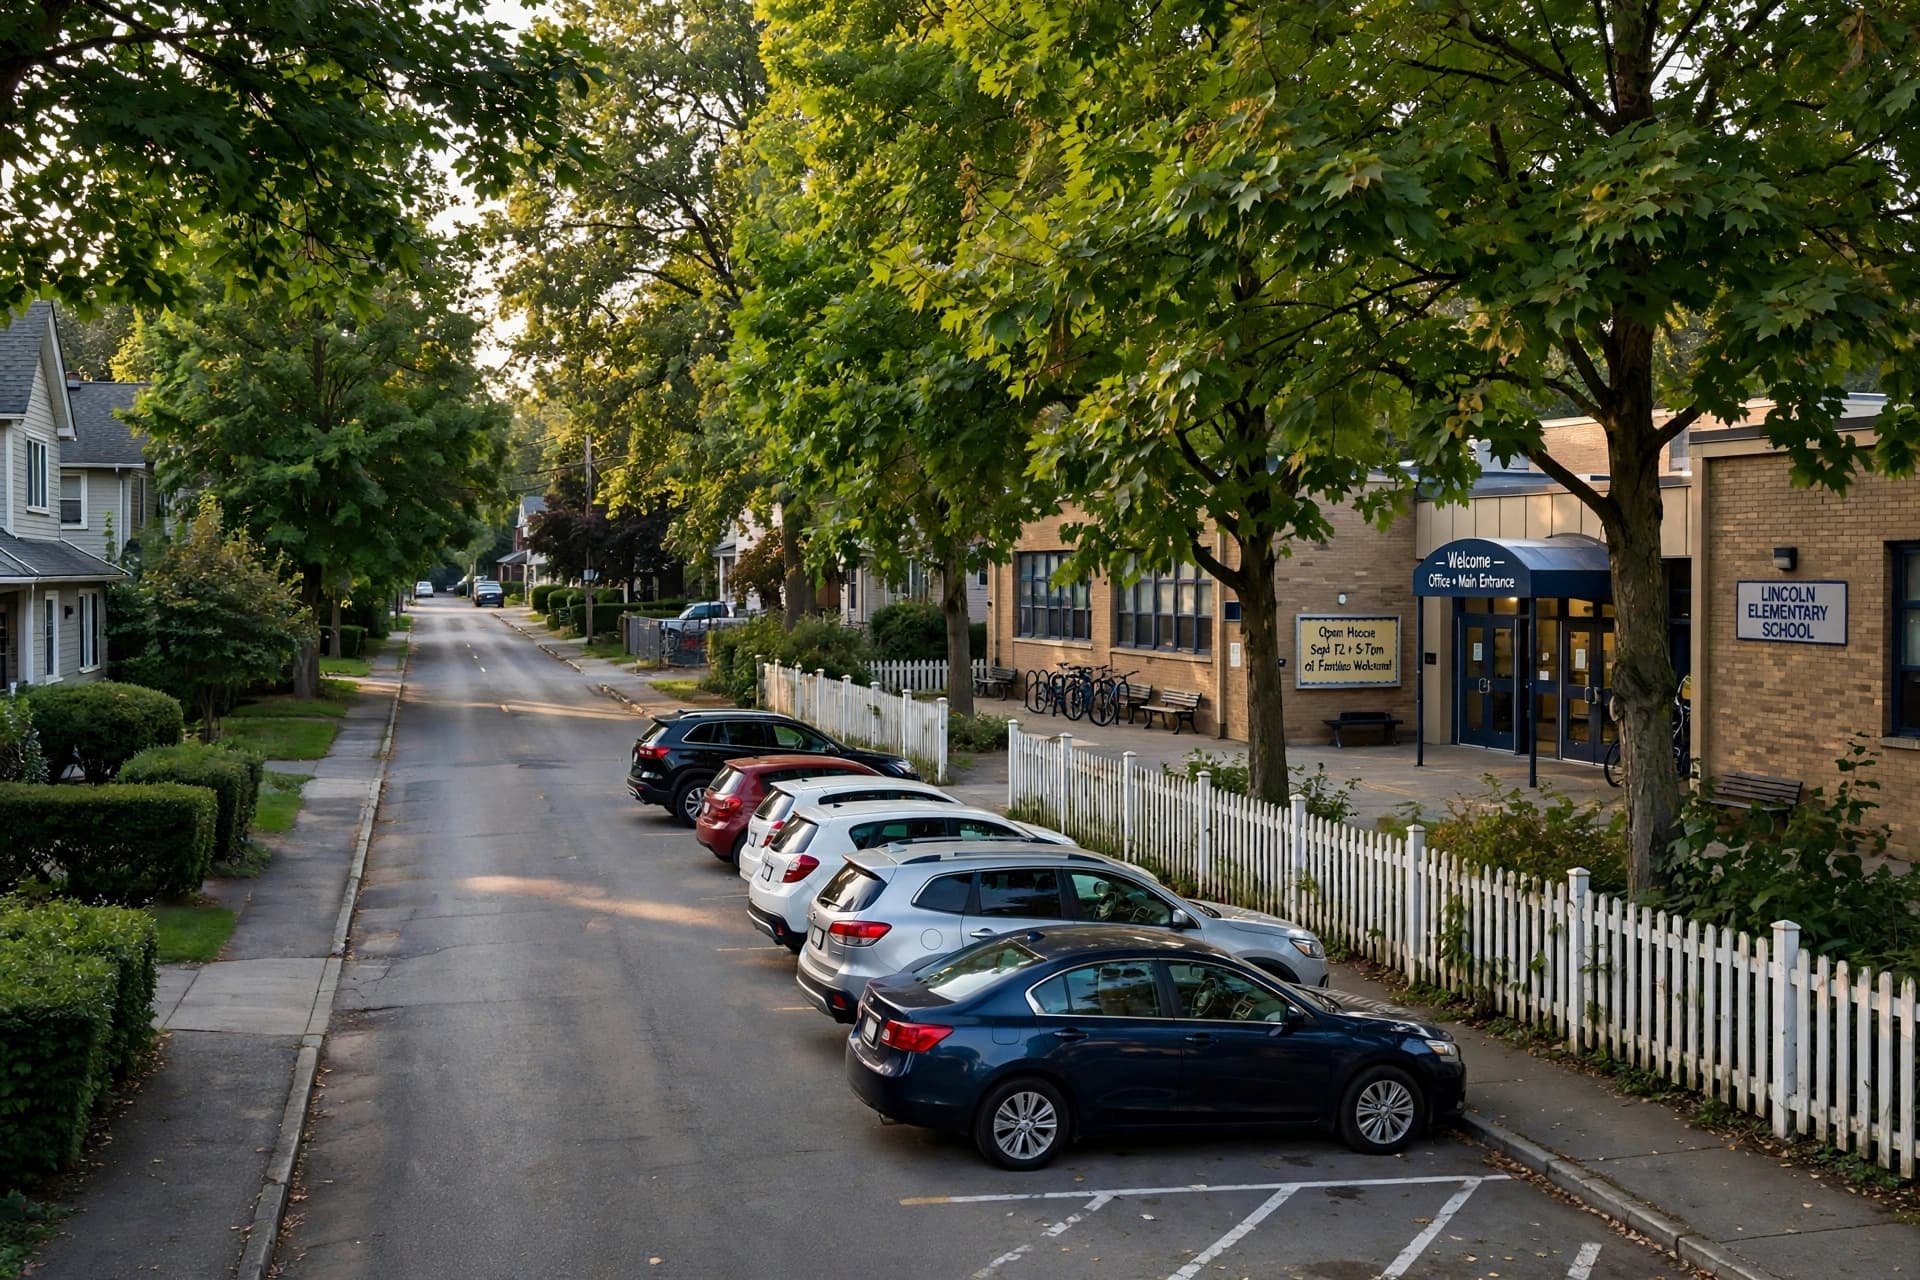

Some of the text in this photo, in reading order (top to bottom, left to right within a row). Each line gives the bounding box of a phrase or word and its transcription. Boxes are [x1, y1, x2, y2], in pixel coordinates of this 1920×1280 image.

[1447, 551, 1491, 569] Welcome
[1428, 573, 1515, 589] Office Main Entrance
[1761, 586, 1815, 603] LINCOLN
[1748, 603, 1828, 621] ELEMENTARY
[1762, 621, 1815, 639] SCHOOL
